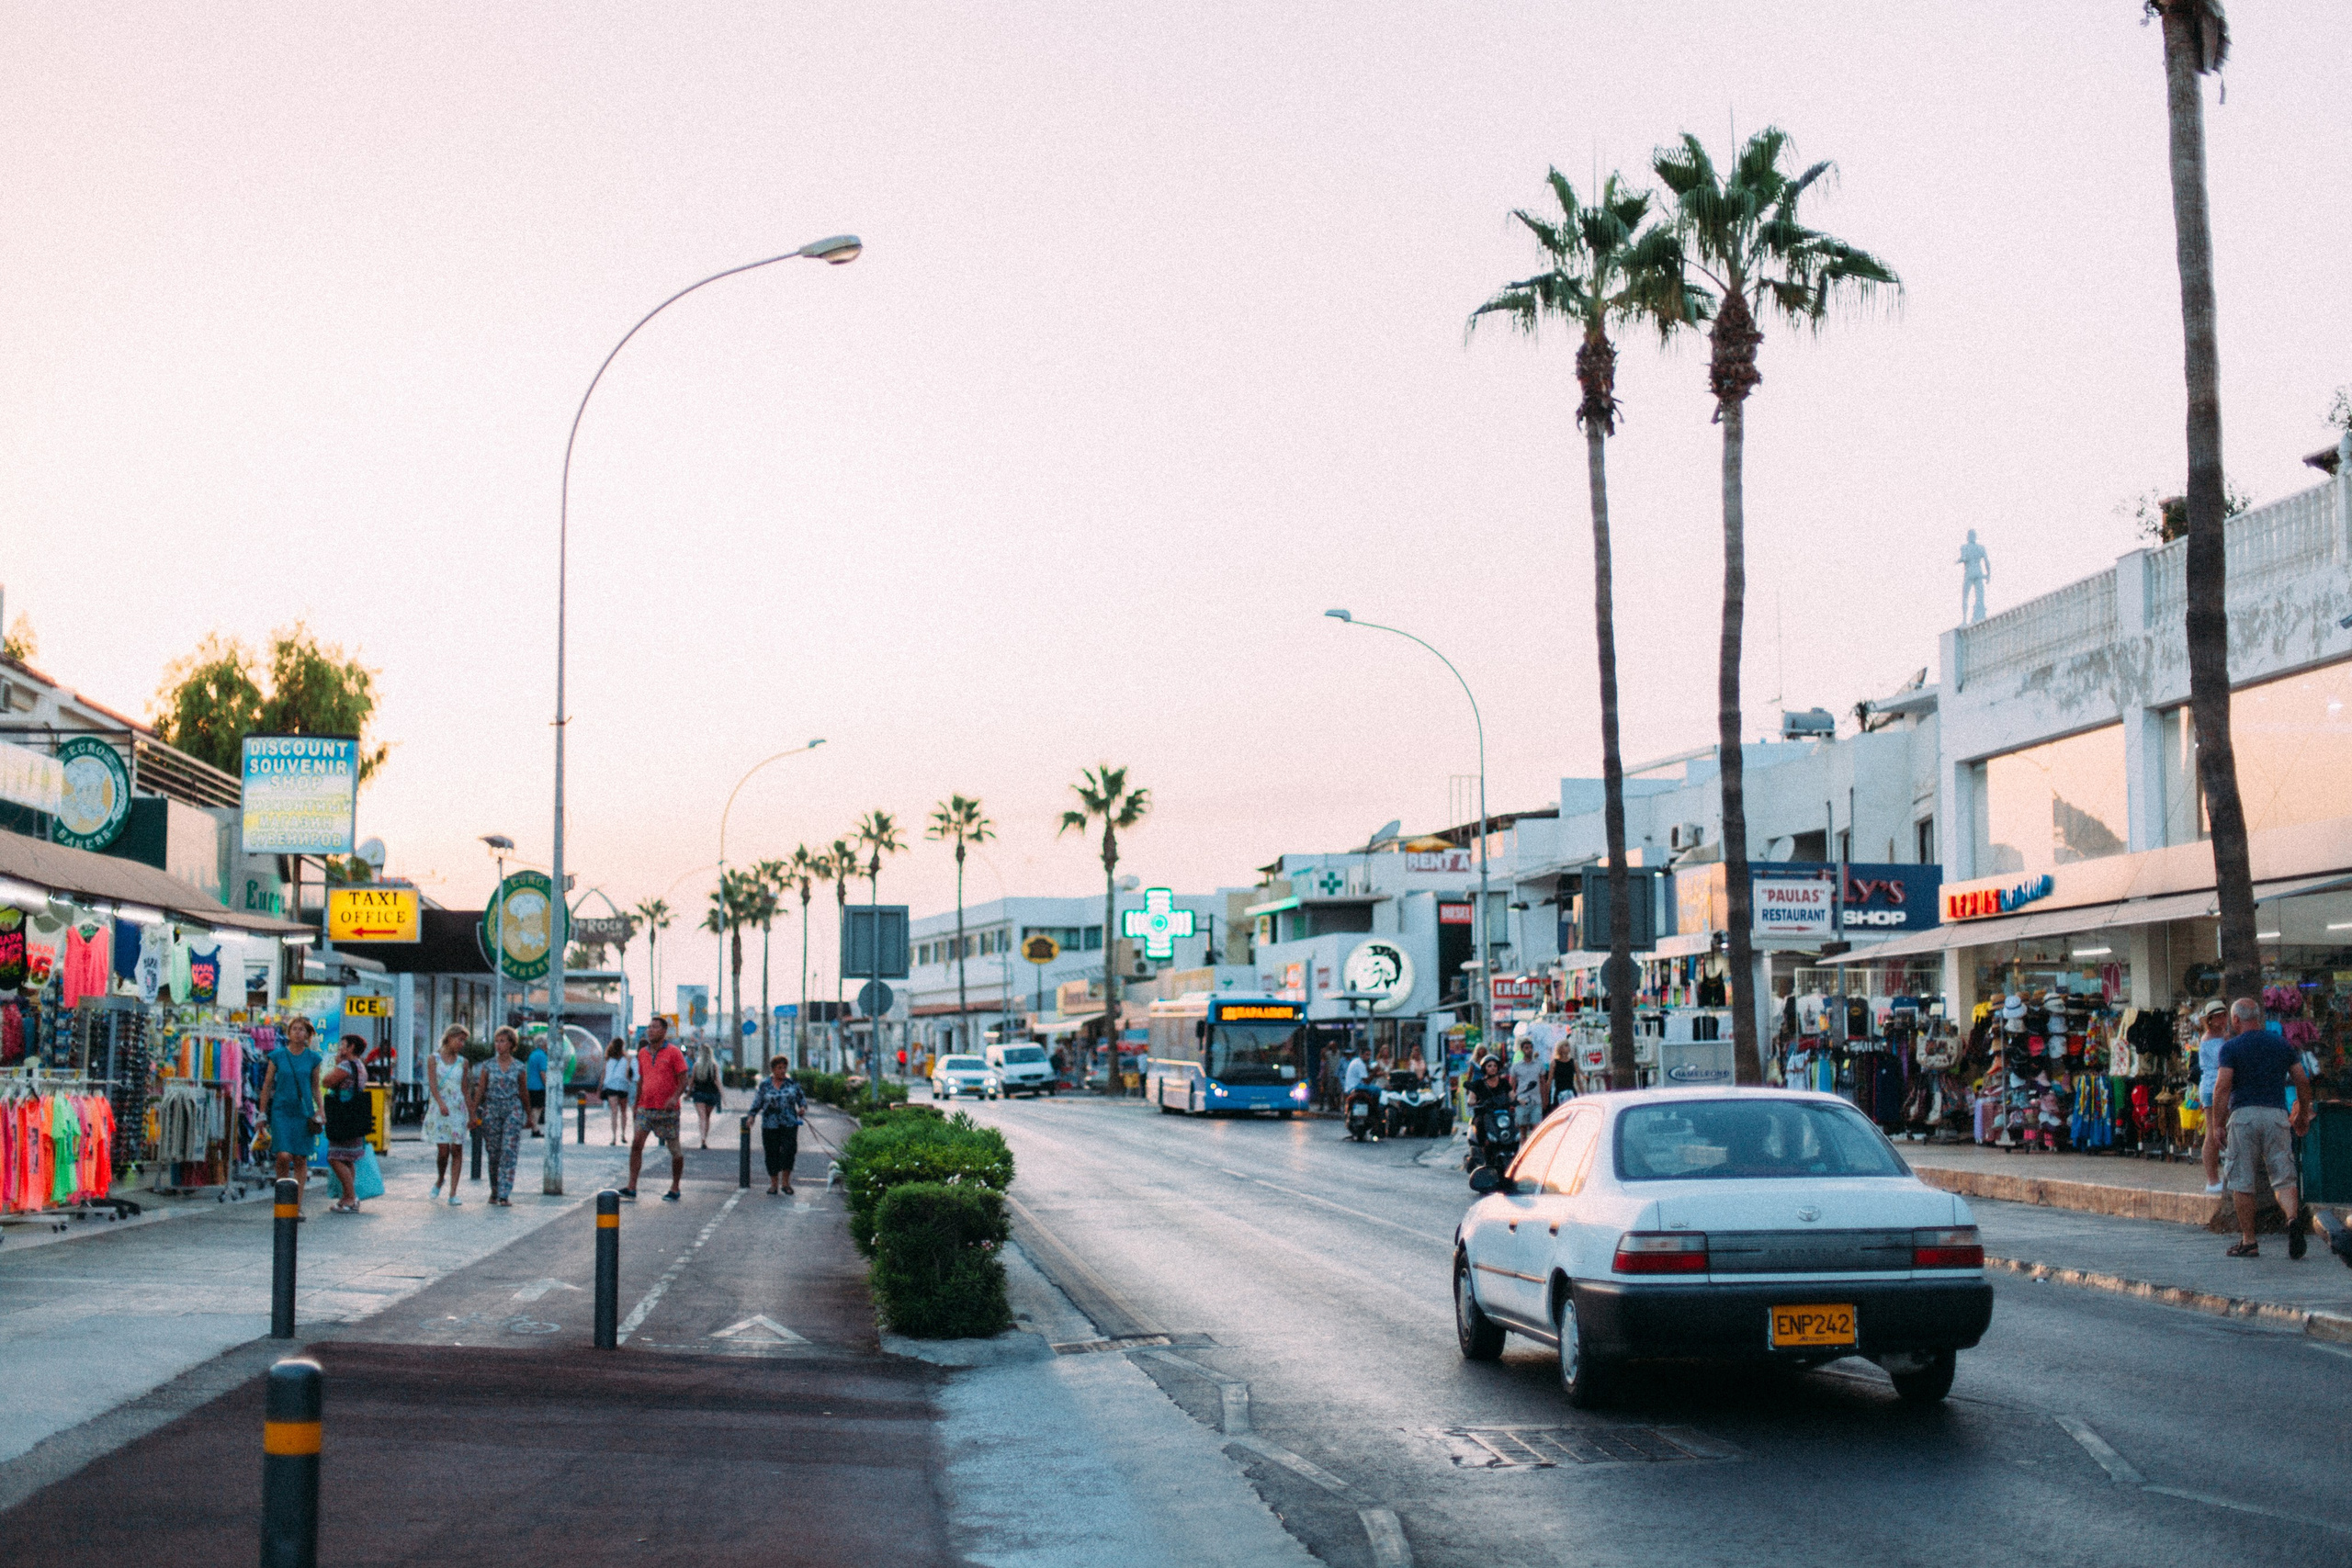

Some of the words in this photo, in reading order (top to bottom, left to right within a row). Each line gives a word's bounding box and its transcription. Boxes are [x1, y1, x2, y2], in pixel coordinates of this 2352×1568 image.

[250, 740, 348, 757] DISCOUNT
[250, 758, 347, 774] SOUVENIR
[270, 776, 322, 790] SHOP
[348, 891, 399, 906] TAXI
[341, 911, 406, 924] OFFICE
[1761, 908, 1826, 921] RESTAURANT
[1843, 910, 1906, 926] SHOP
[349, 999, 378, 1014] ICE
[1776, 1314, 1851, 1336] ENP242
